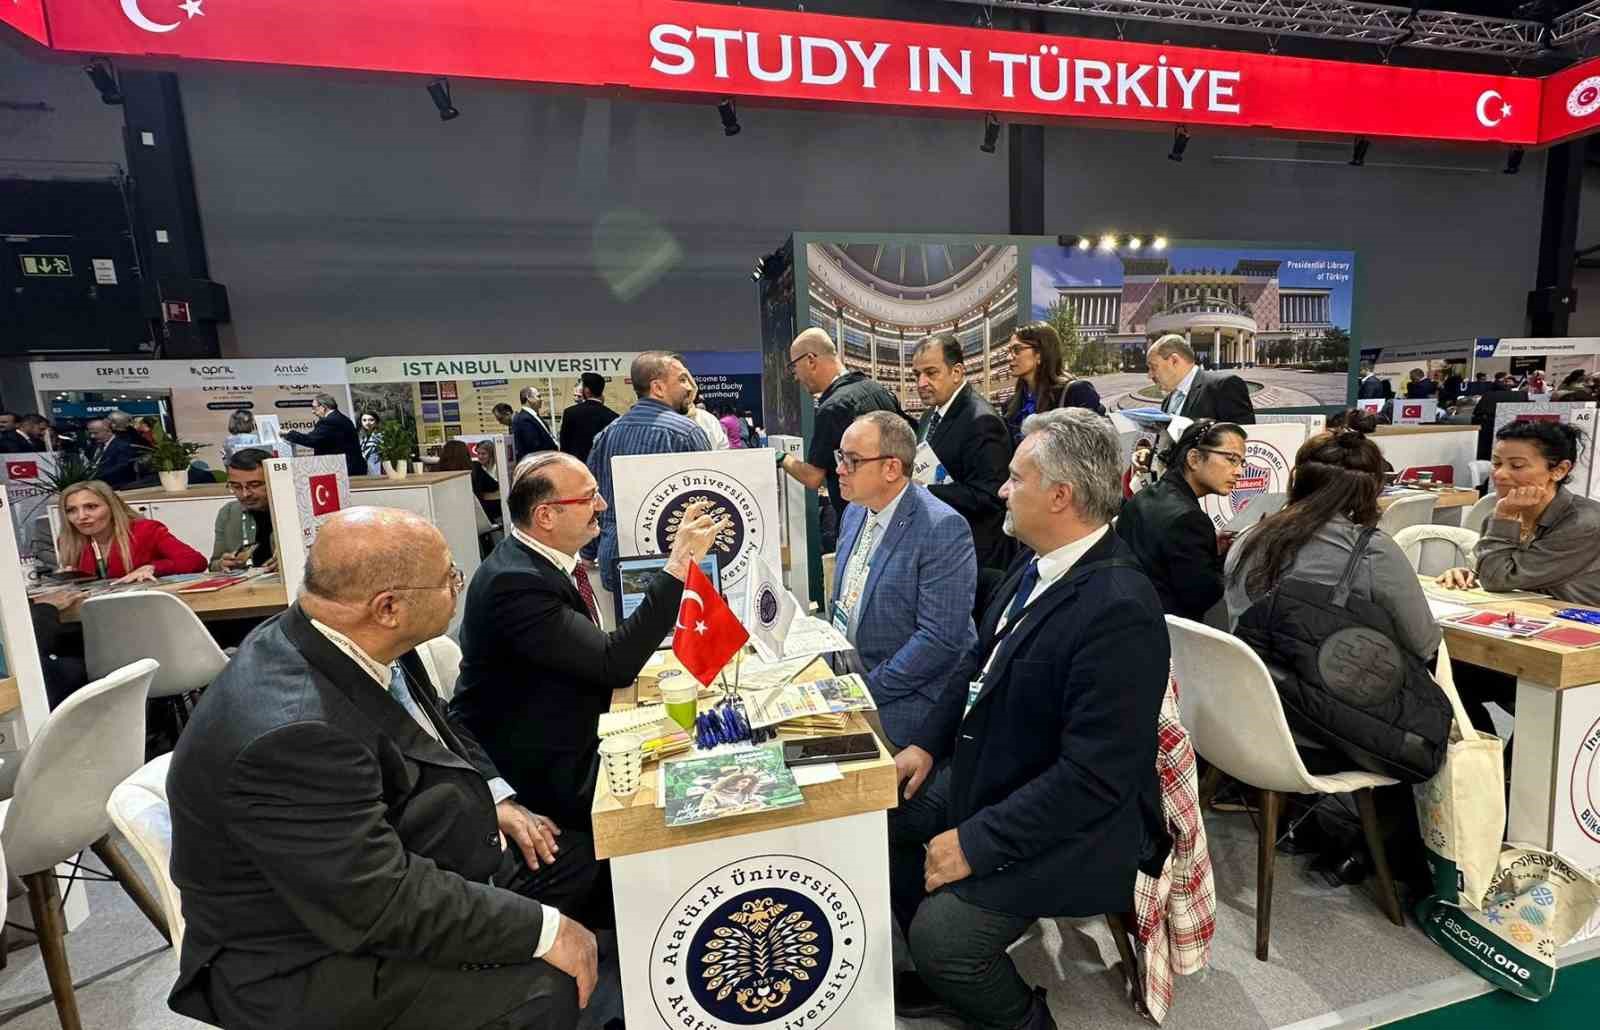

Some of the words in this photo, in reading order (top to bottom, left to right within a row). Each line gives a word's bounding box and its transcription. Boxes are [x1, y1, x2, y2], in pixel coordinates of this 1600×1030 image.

[649, 23, 890, 88] STUDY
[907, 44, 973, 95] IN
[988, 44, 1242, 113] TÜRKİYE
[1287, 260, 1326, 270] Presidential
[1327, 261, 1350, 271] Library
[1316, 273, 1325, 281] of
[1326, 272, 1349, 282] Türkiye
[273, 363, 309, 374] Antaé
[354, 365, 378, 375] P154
[402, 361, 504, 377] ISTANBUL
[510, 357, 623, 373] UNIVERSITY
[719, 375, 727, 383] to
[699, 383, 720, 391] Grand
[721, 382, 743, 392] Duchy
[1576, 413, 1590, 421] A6
[790, 443, 801, 451] B7
[1247, 444, 1283, 472] oğramacı
[273, 463, 288, 472] B8
[642, 482, 679, 531] Atatürk
[682, 475, 758, 523] Üniversitesi
[720, 541, 758, 582] versity
[663, 883, 724, 966] Atatürk
[731, 865, 854, 930] Üniversitesi
[1445, 917, 1531, 980] ascentone
[784, 958, 855, 1030] iversity
